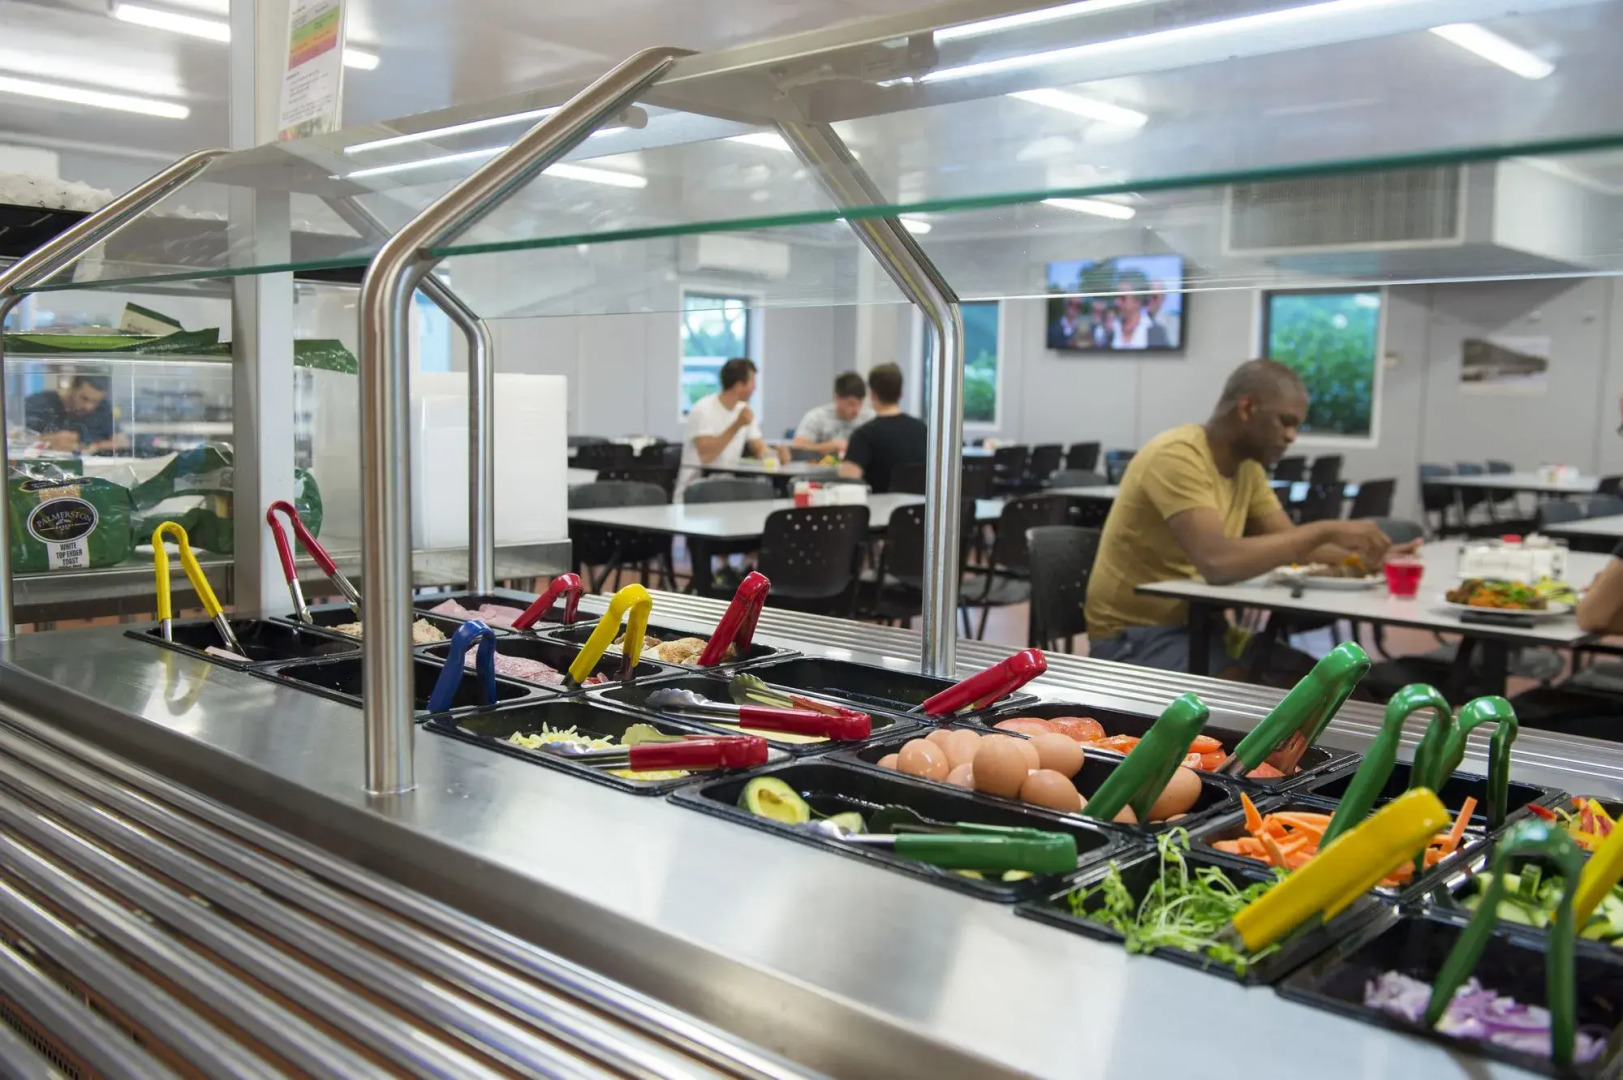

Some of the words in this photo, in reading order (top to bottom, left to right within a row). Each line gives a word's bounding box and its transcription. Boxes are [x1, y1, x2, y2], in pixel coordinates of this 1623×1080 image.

[36, 511, 92, 528] PALMERSTON
[60, 542, 77, 551] WHITE
[56, 551, 66, 559] TOP
[63, 557, 78, 566] TOAST
